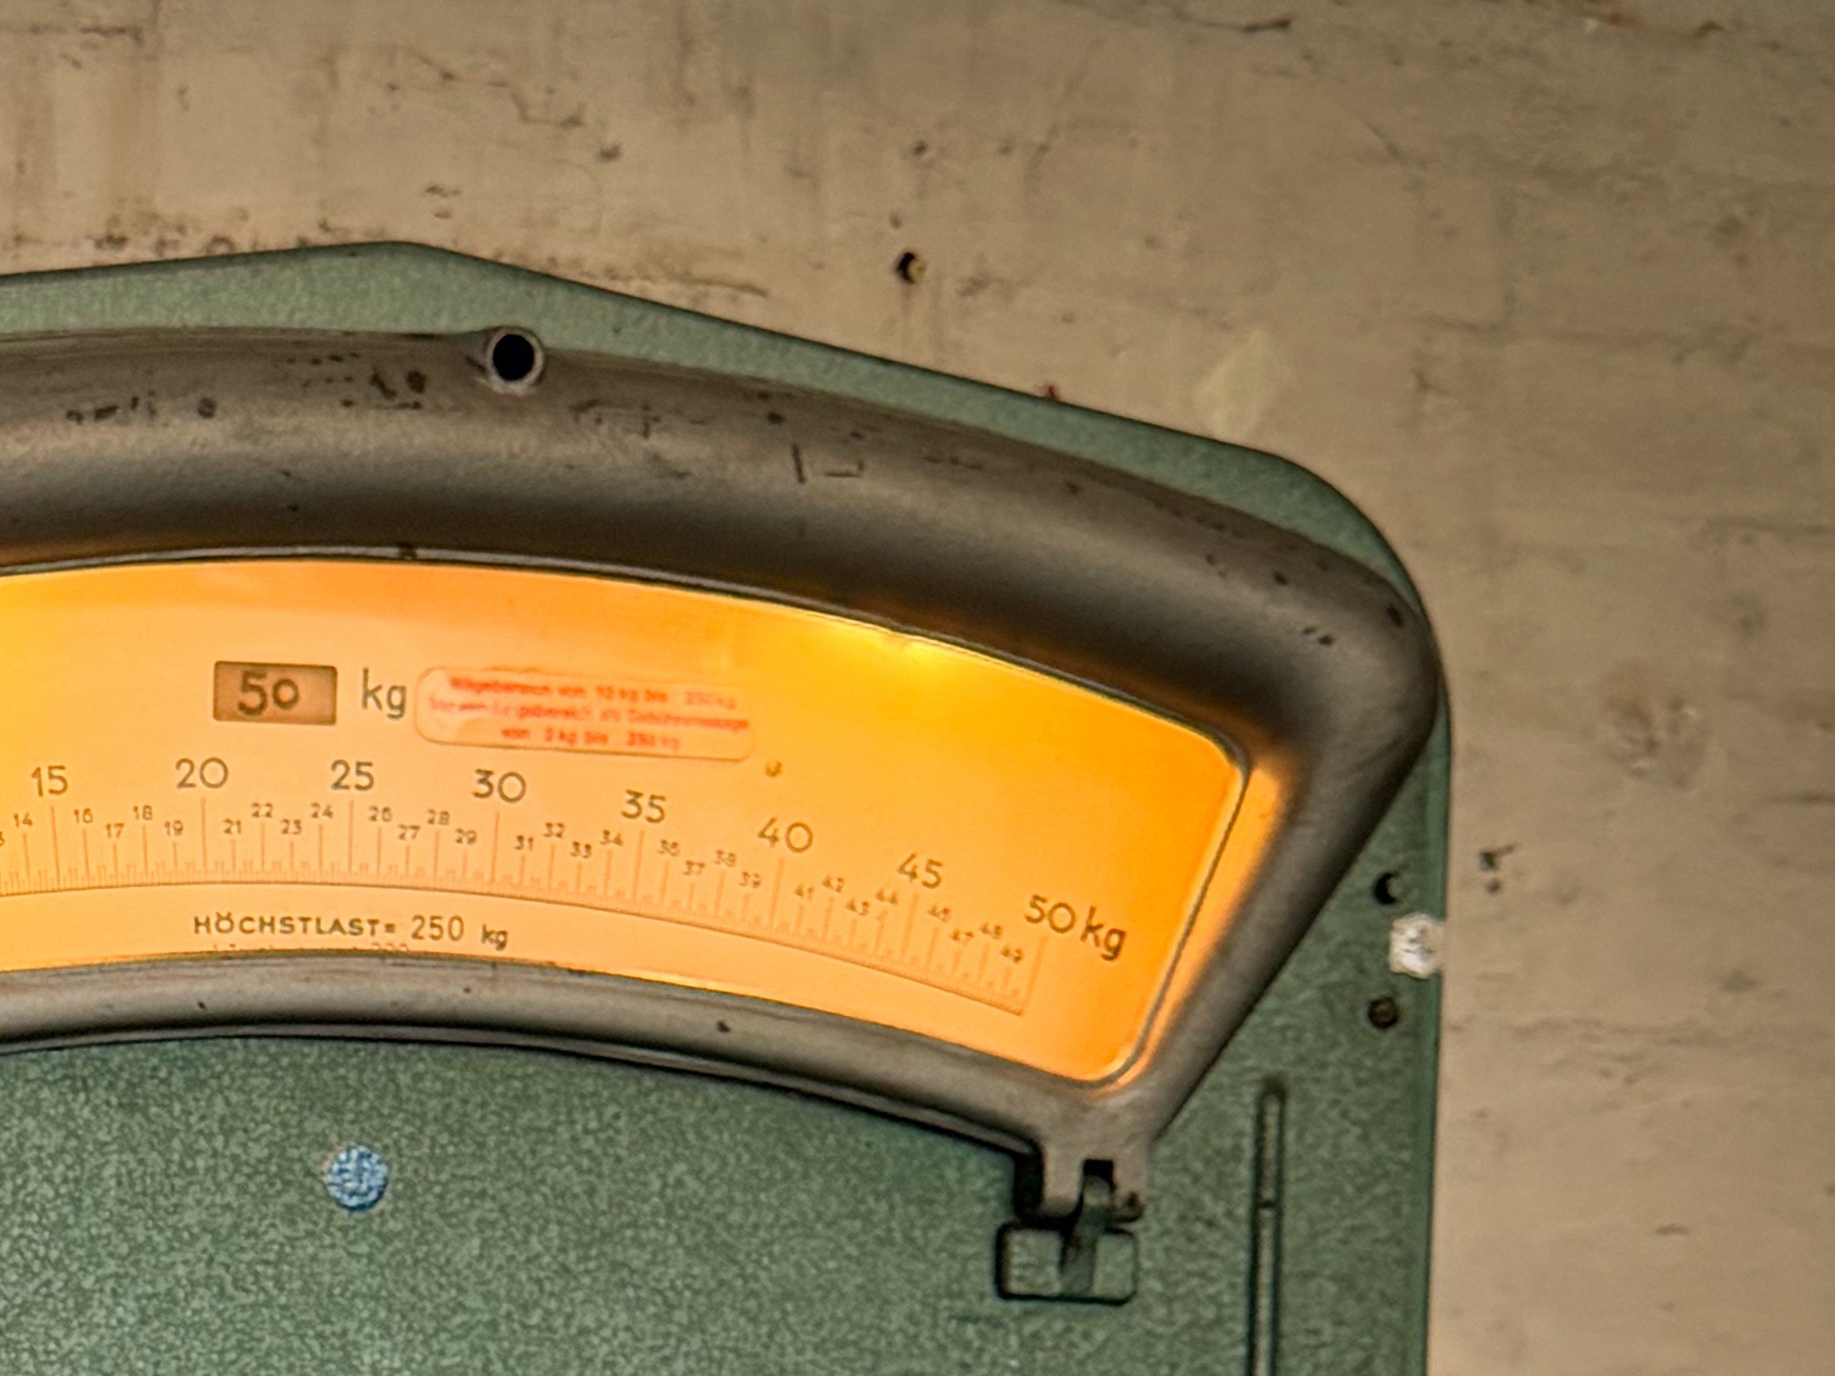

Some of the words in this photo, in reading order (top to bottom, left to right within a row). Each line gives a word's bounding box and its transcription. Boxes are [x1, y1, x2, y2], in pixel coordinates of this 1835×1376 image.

[238, 670, 299, 717] 50
[361, 668, 407, 719] kg
[14, 812, 33, 827] 14
[73, 808, 93, 824] 16
[105, 822, 125, 839] 17
[132, 805, 153, 821] 18
[164, 820, 184, 836] 19
[222, 818, 242, 835] 21
[250, 803, 274, 819] 22
[280, 819, 303, 835] 23
[310, 803, 334, 819] 24
[367, 806, 393, 823] 26
[397, 824, 420, 841] 27
[426, 808, 450, 826] 28
[455, 829, 478, 845] 29
[514, 834, 534, 851] 31
[543, 822, 565, 838] 32
[569, 841, 592, 859] 33
[599, 829, 624, 847] 34
[31, 765, 68, 797] 15
[175, 757, 229, 789] 20
[330, 759, 375, 791] 25
[472, 768, 527, 804] 30
[621, 789, 667, 824] 35
[757, 816, 813, 853] 40
[897, 853, 943, 889] 45
[411, 914, 465, 942] 250
[481, 924, 509, 951] kg
